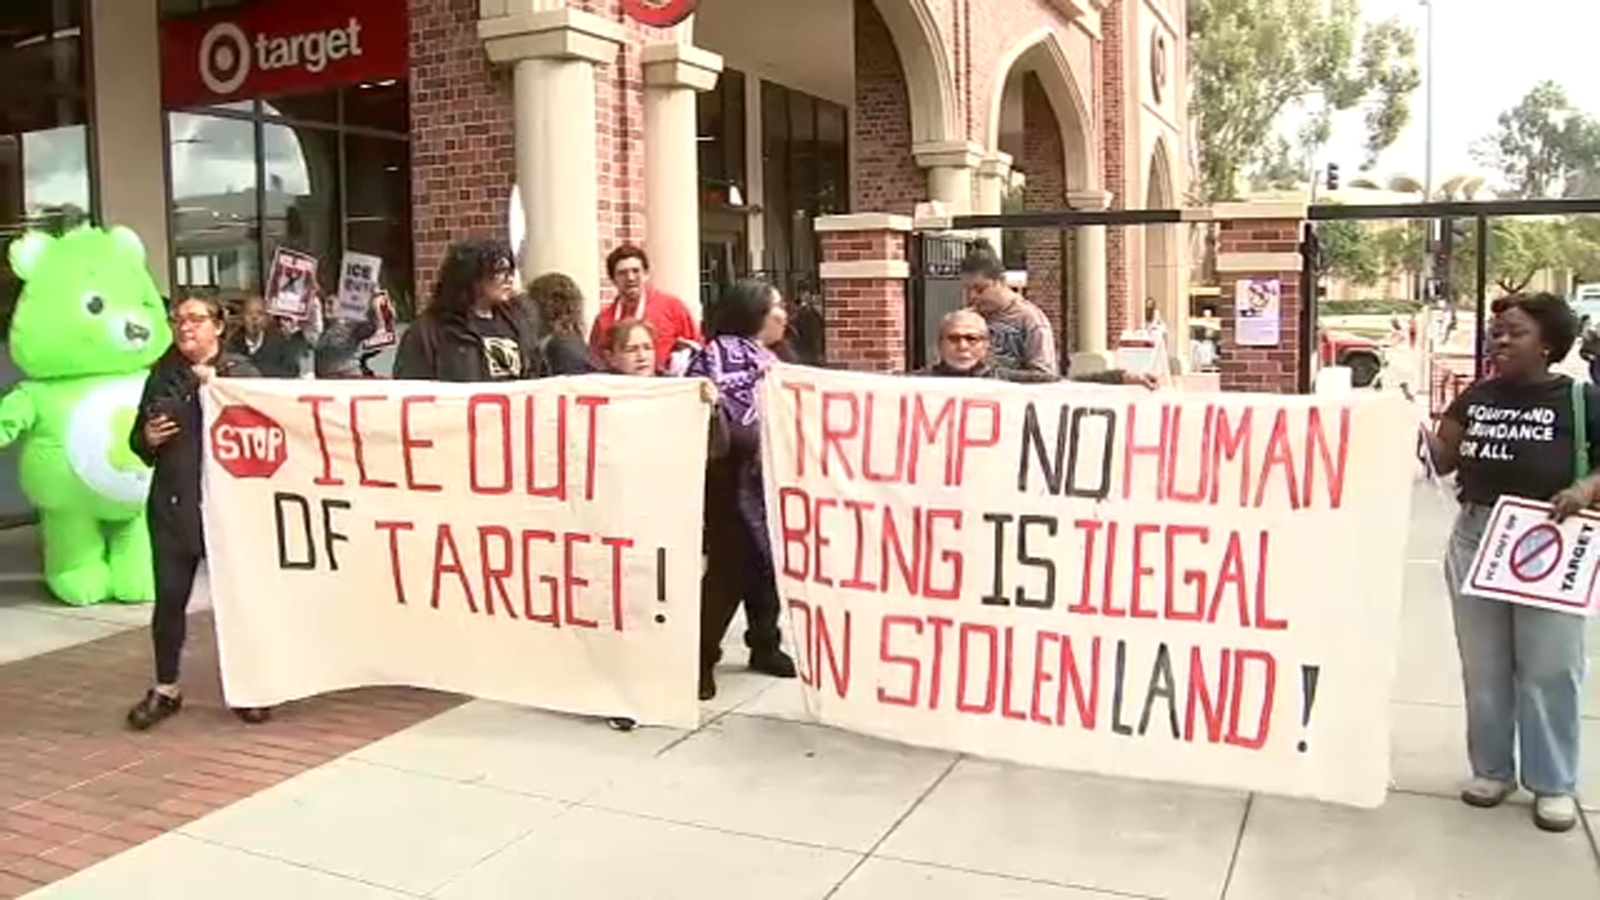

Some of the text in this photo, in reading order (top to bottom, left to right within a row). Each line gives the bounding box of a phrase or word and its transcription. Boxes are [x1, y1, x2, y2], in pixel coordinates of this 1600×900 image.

[254, 17, 362, 75] target
[346, 263, 372, 280] ICE
[214, 424, 285, 463] STOP
[298, 393, 610, 501] ICE OUT
[779, 381, 1351, 510] TRUMP NO HUMAN
[1480, 443, 1515, 460] ALL.
[273, 491, 352, 571] OF
[375, 520, 634, 631] TARGET
[779, 486, 1289, 631] BEING IS ILEGAL
[1561, 522, 1594, 592] TARGET
[789, 598, 851, 700] ON
[877, 615, 1101, 731] STOLEN
[1112, 639, 1276, 751] LAND
